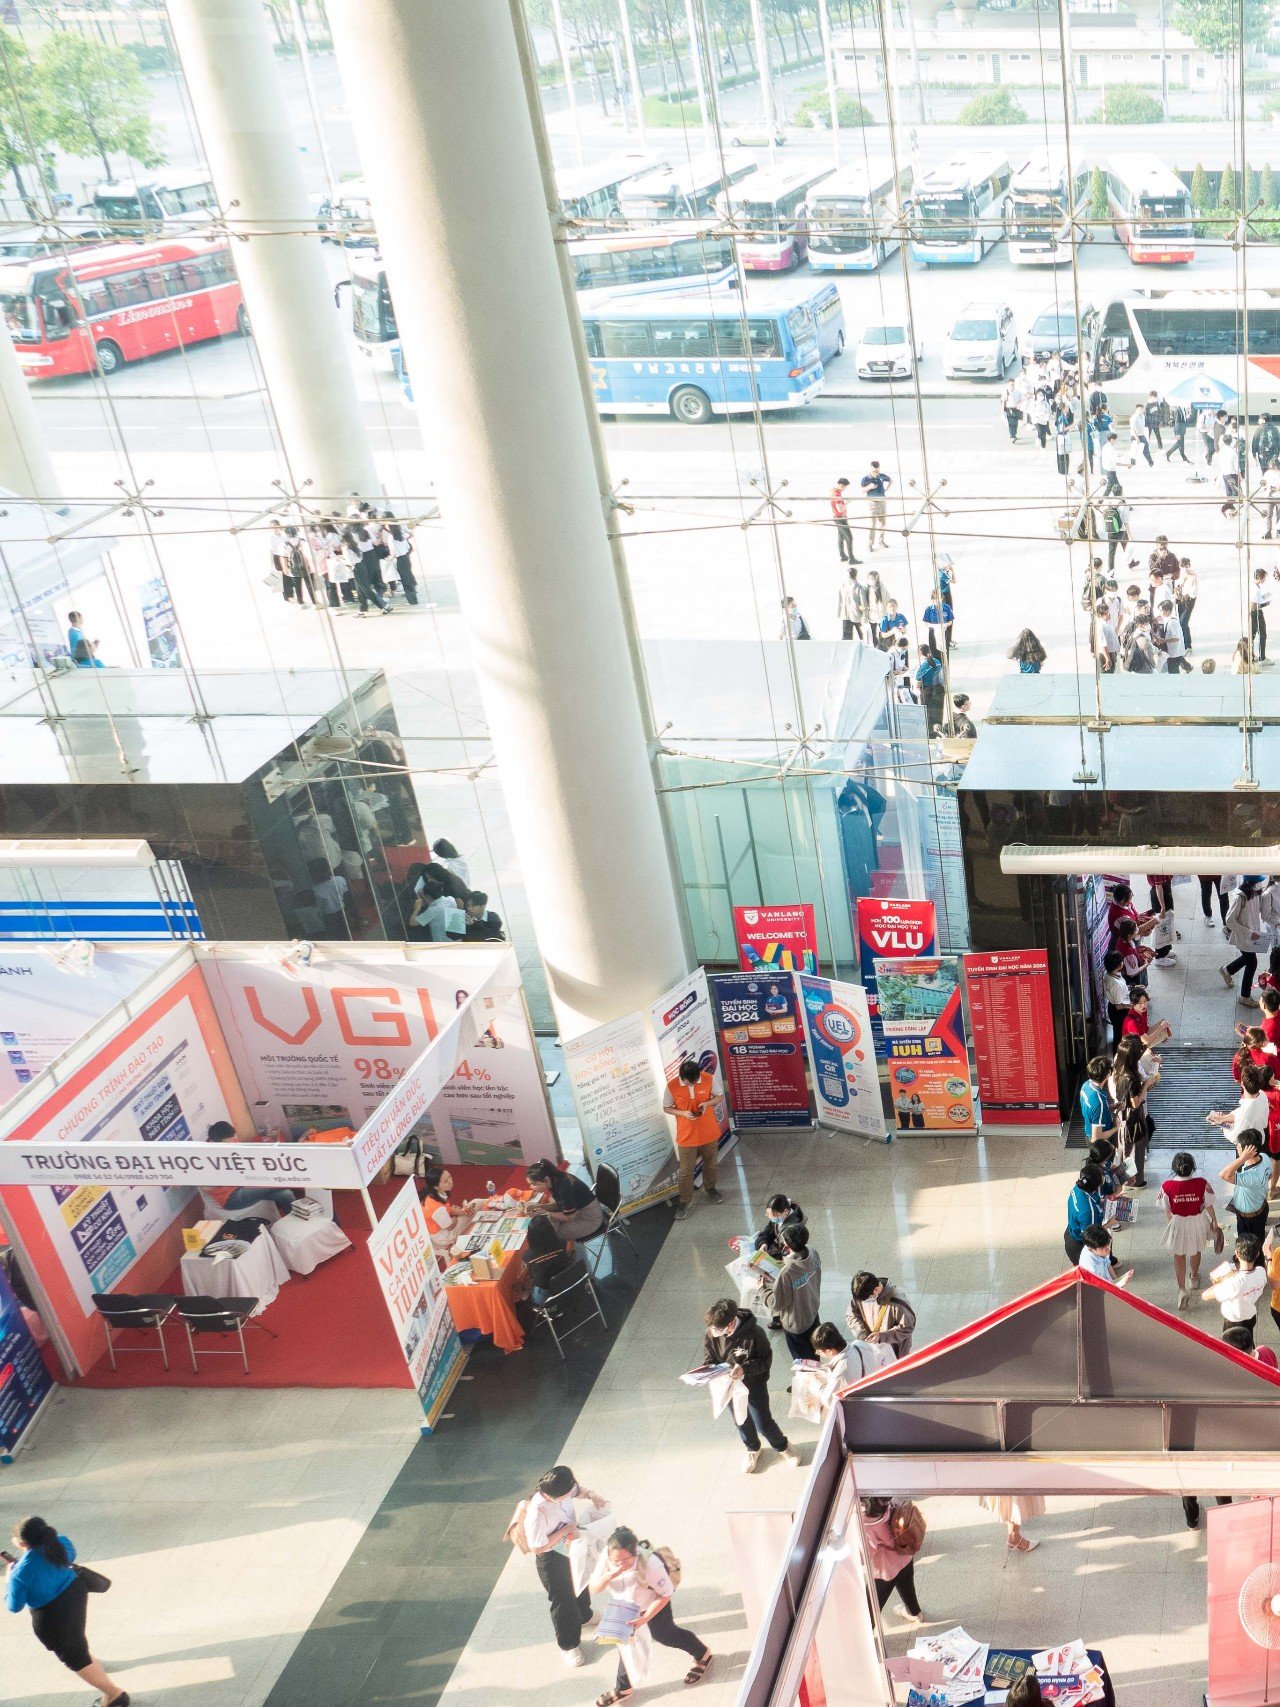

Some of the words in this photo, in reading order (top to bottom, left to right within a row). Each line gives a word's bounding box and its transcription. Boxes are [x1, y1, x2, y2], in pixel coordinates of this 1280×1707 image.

[747, 931, 792, 940] WELCOME
[870, 931, 924, 949] VLU
[721, 1005, 737, 1013] ĐẠI
[738, 1004, 758, 1012] HỌC
[722, 1012, 760, 1023] 2024
[774, 1024, 794, 1032] DKB
[828, 1019, 849, 1031] UEL
[307, 1054, 329, 1064] QUỐC
[330, 1053, 340, 1063] TẾ
[733, 1046, 747, 1054] 18
[892, 1045, 923, 1056] IUH
[354, 1057, 407, 1080] 98%
[452, 1059, 492, 1082] 4%
[58, 1097, 101, 1140] CHƯƠNG
[98, 1068, 128, 1101] TRÌNH
[127, 1052, 148, 1075] ĐÀO
[145, 1035, 165, 1056] TẠO
[361, 1124, 383, 1157] TIÊU
[380, 1096, 408, 1135] CHUẨN
[405, 1077, 423, 1103] ĐỨC
[366, 1146, 388, 1174] CHẤT
[385, 1114, 413, 1153] LƯỢNG
[411, 1093, 428, 1119] ĐỨC
[22, 1152, 110, 1171] TRƯỜNG
[116, 1155, 155, 1174] ĐẠI
[159, 1155, 204, 1173] HỌC
[206, 1152, 256, 1174] VIỆT
[263, 1152, 307, 1172] ĐỨC
[379, 1207, 420, 1277] VGU
[388, 1235, 426, 1297] CAMPUS
[393, 1259, 426, 1325] TOUR
